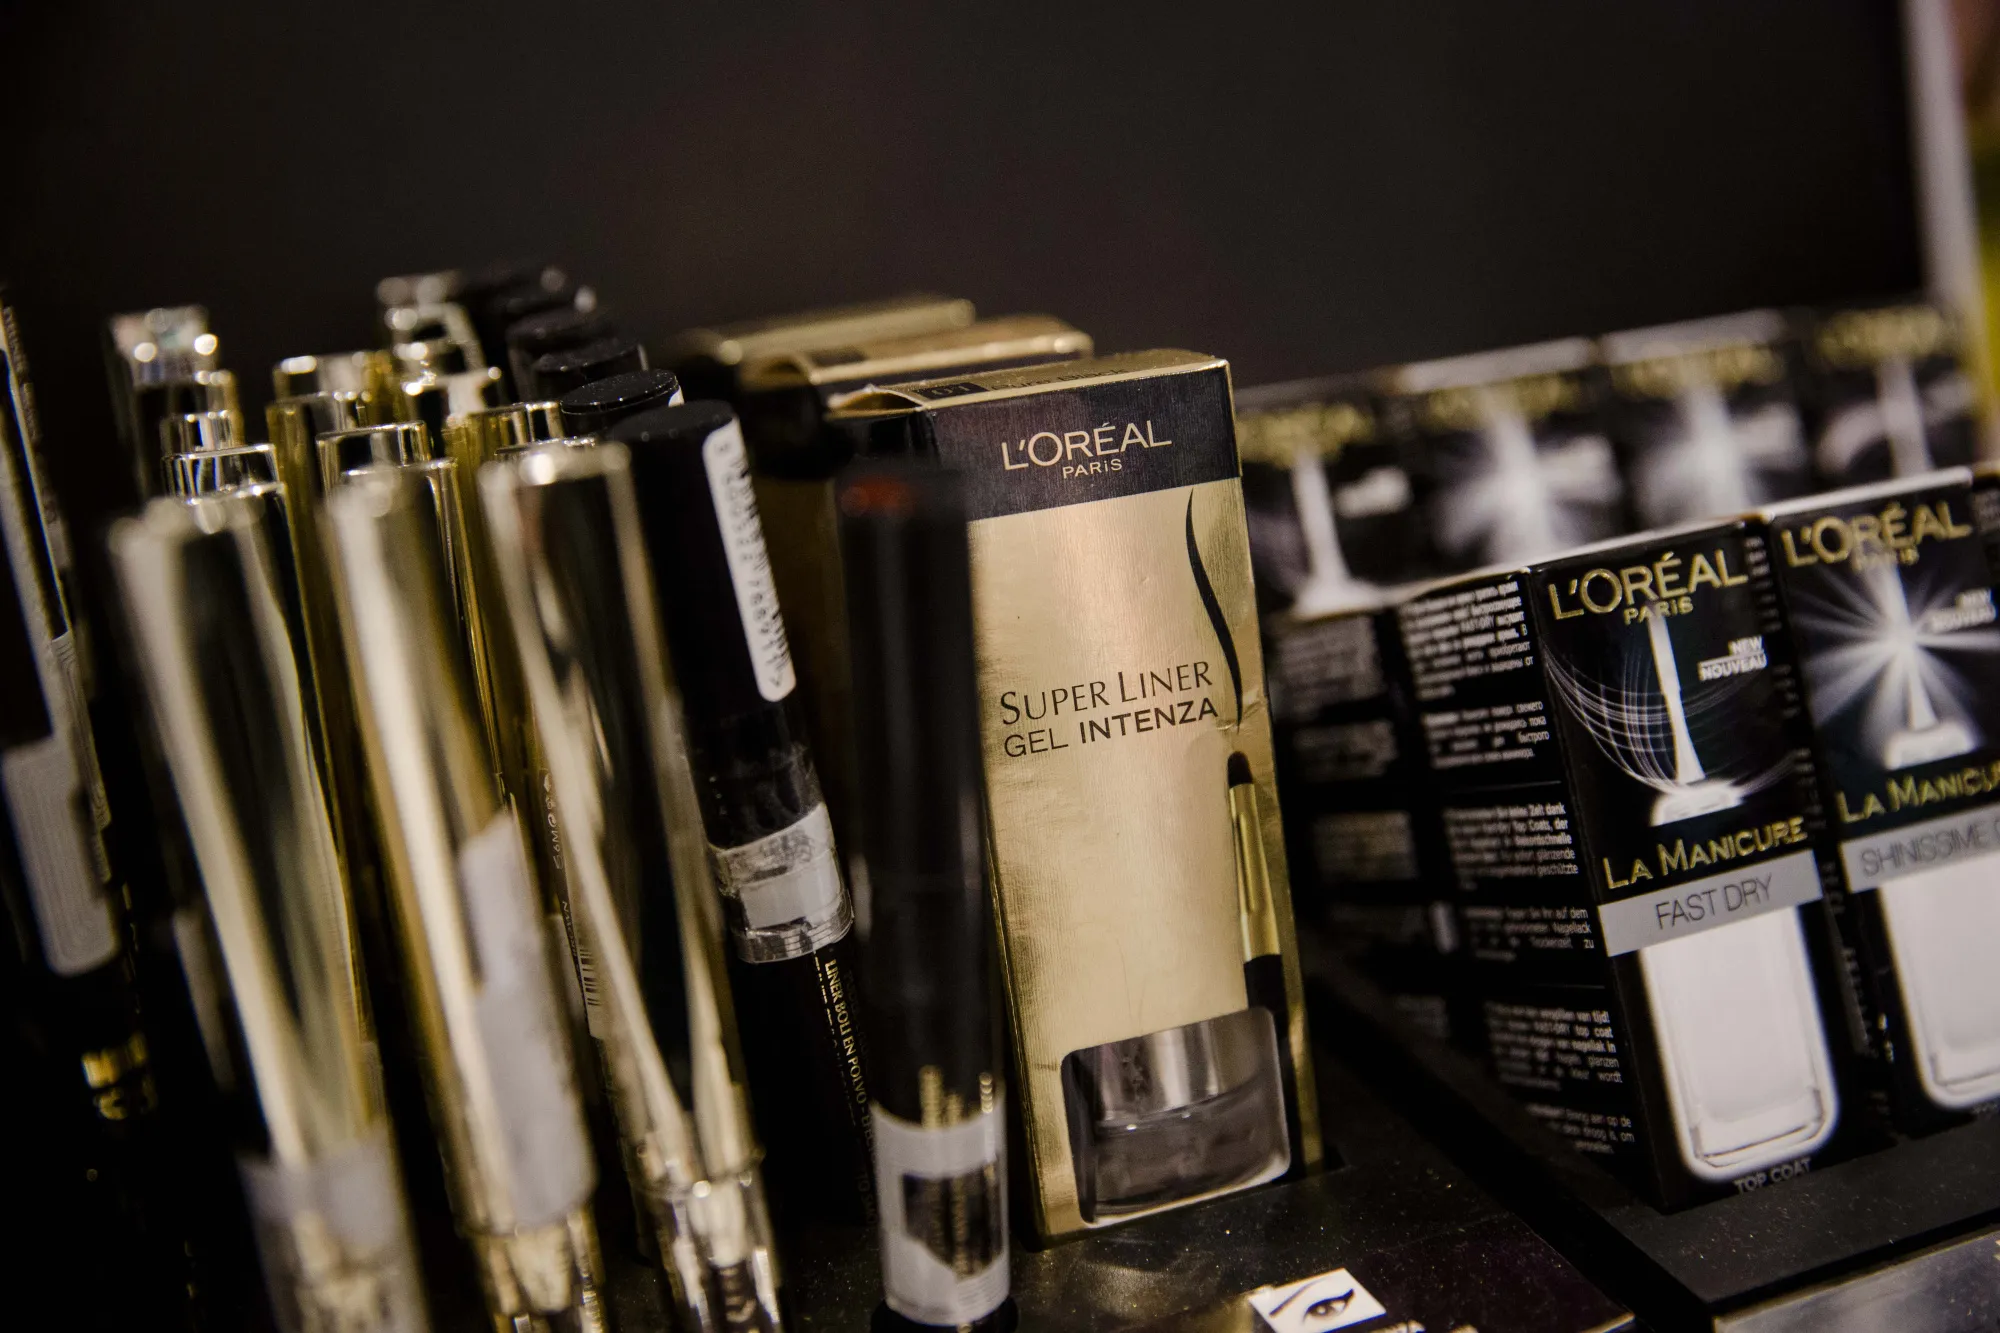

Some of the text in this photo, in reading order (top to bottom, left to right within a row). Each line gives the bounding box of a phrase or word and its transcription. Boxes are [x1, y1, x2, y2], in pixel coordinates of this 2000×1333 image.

[1001, 419, 1172, 470] L'ORÉAL
[1781, 501, 1973, 567] L'ORÉAL
[1548, 549, 1749, 620] L'ORÉAL
[1698, 653, 1768, 681] NOUVEAU
[1728, 635, 1764, 655] NEW
[1001, 660, 1213, 725] SUPER LINER
[1004, 696, 1219, 758] GEL INTENZA
[1835, 791, 1886, 823] LA
[1603, 816, 1808, 889] LA MANICURE
[1655, 888, 1718, 930] FAST
[1723, 872, 1773, 911] DRY
[824, 958, 843, 1002] LINER
[835, 1000, 854, 1036] BOLI
[842, 1034, 857, 1056] EN
[848, 1057, 868, 1105] POLVO
